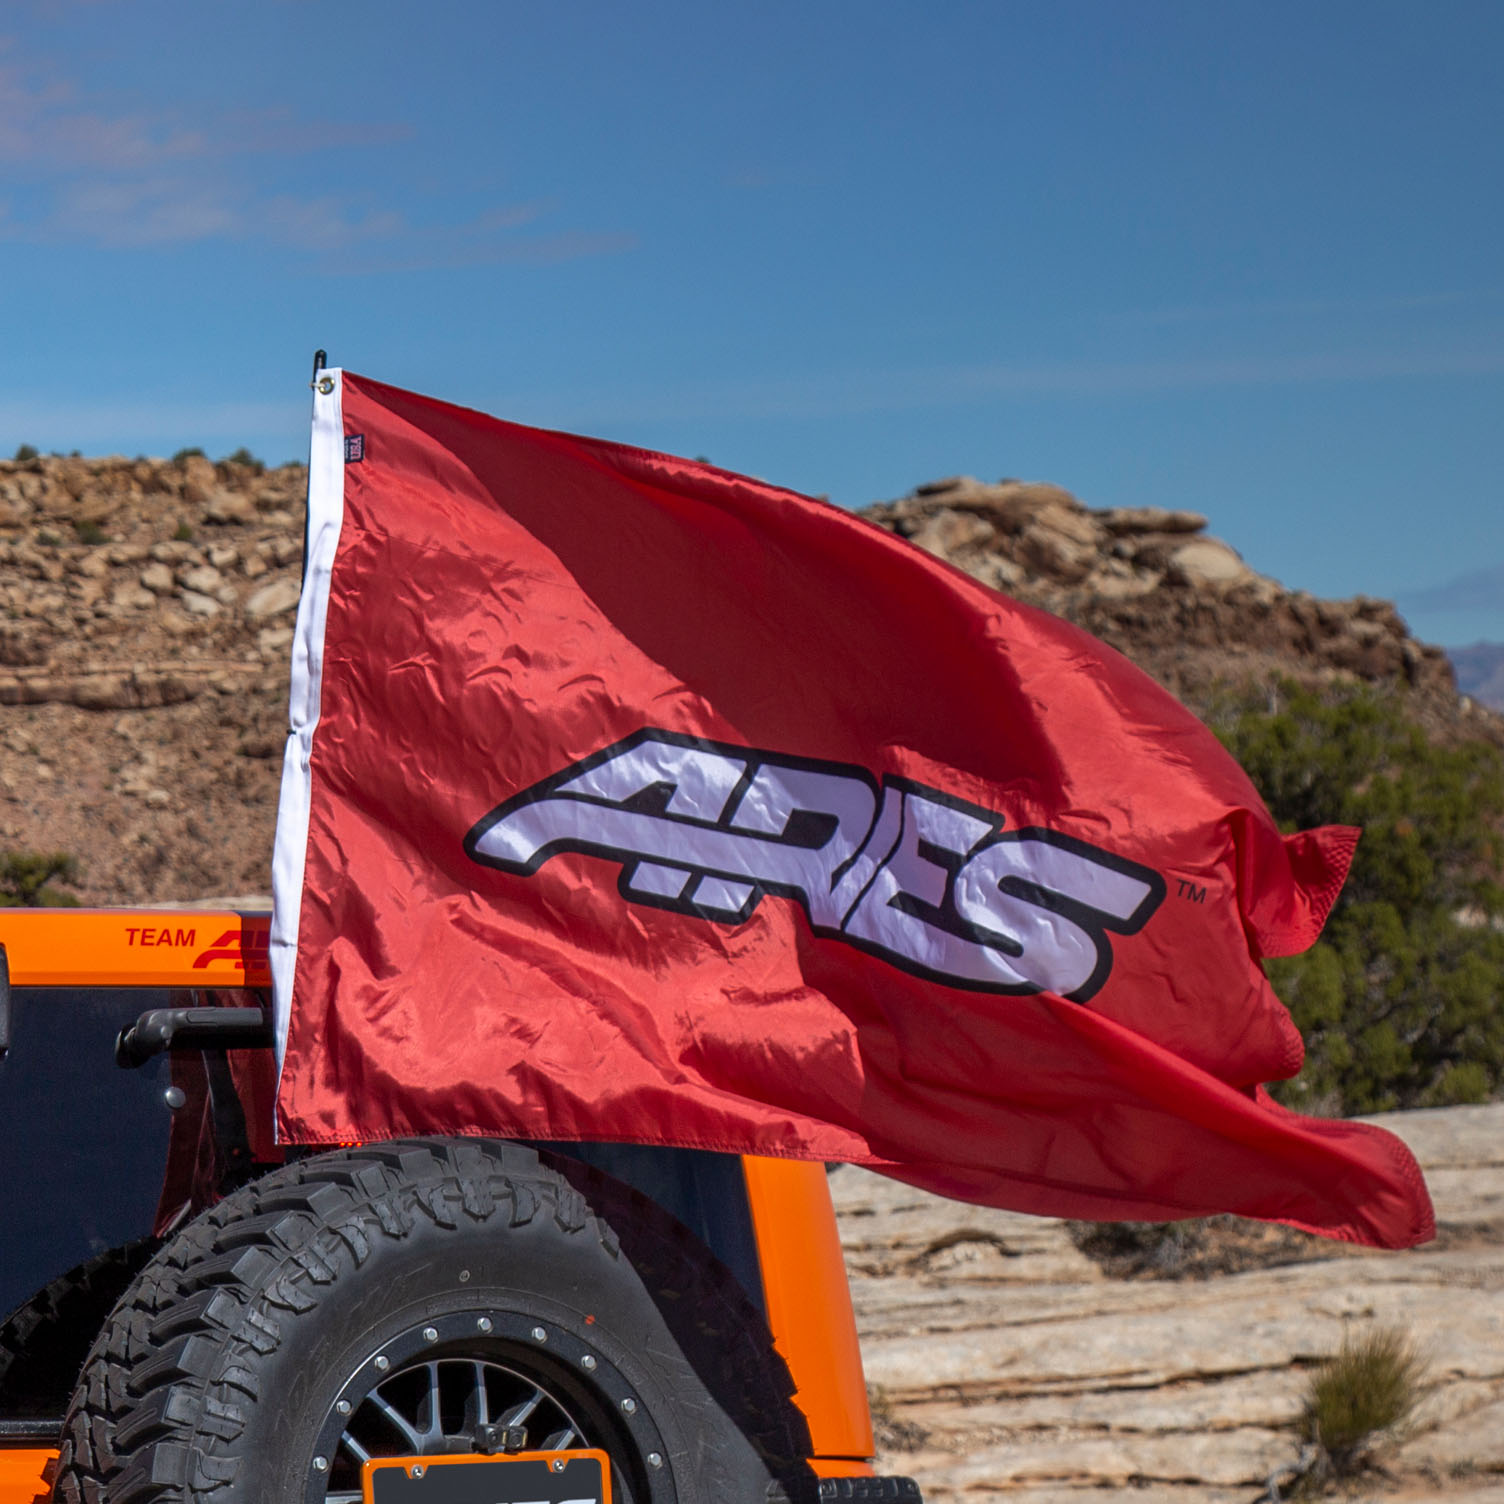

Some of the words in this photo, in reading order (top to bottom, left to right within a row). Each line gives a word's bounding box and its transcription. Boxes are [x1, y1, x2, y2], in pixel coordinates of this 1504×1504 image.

[125, 928, 196, 947] TEAM
[464, 728, 1166, 1001] ARIES
[1177, 878, 1207, 905] TM
